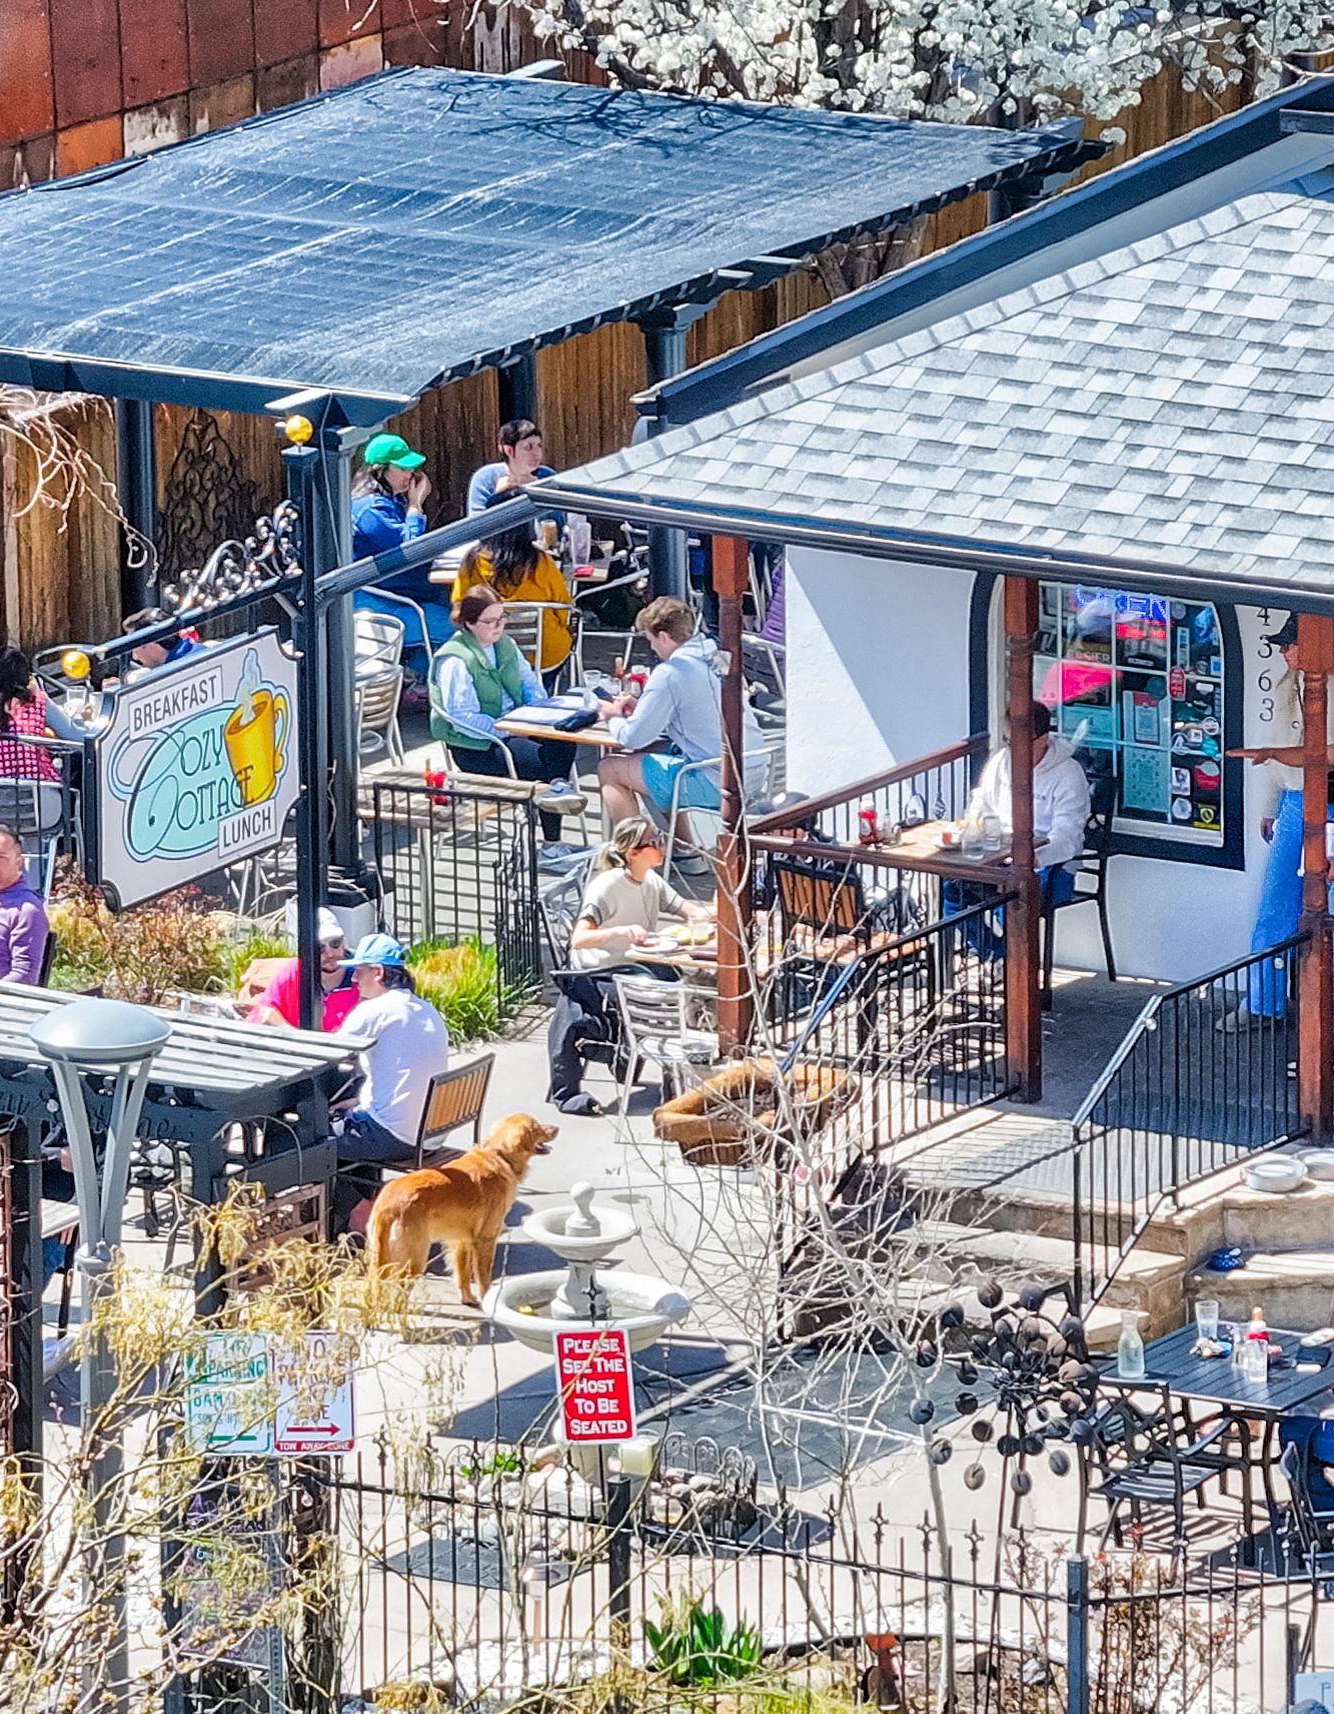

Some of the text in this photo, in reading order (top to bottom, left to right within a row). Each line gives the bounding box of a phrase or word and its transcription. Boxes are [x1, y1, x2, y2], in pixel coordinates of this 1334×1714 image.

[133, 675, 217, 731] BREAKFAST
[223, 806, 271, 847] LUNCH
[563, 1338, 620, 1353] PLEASE
[593, 1357, 625, 1373] THE
[576, 1378, 615, 1394] HOST
[574, 1398, 620, 1414] TO BE
[570, 1418, 627, 1435] SEATED
[279, 1442, 297, 1450] TOW
